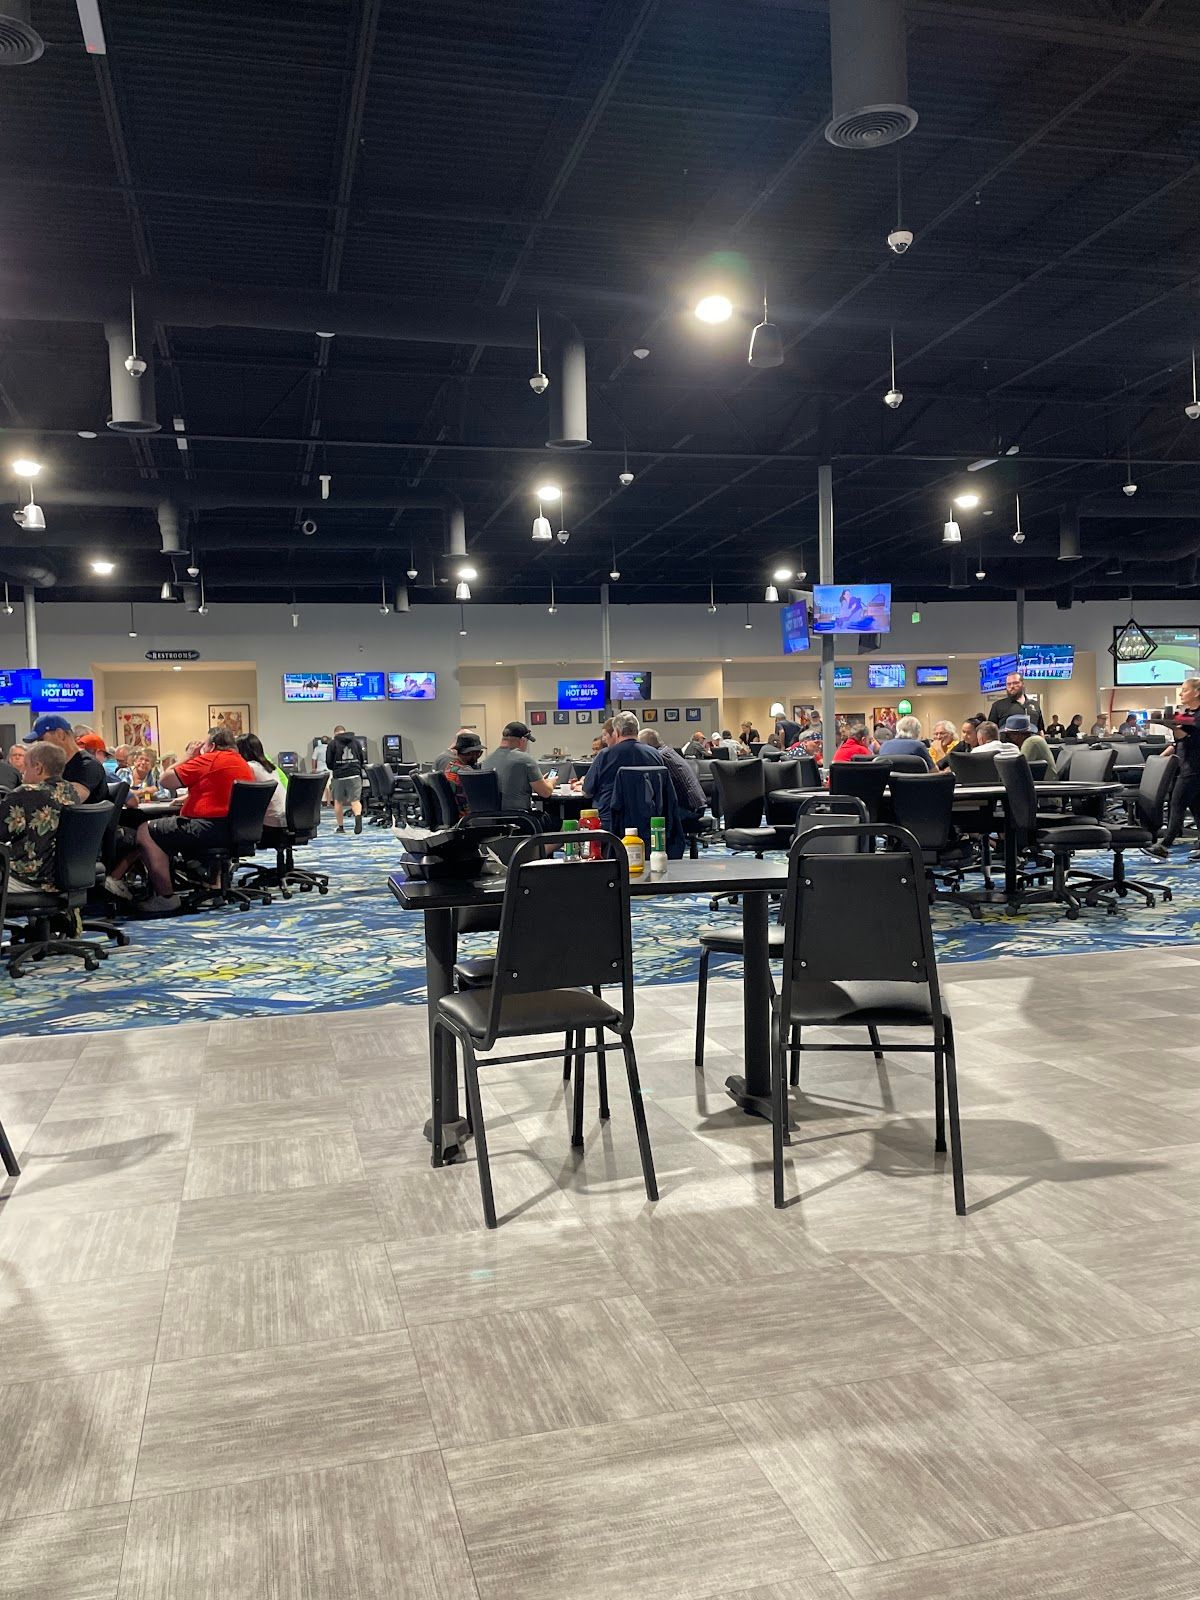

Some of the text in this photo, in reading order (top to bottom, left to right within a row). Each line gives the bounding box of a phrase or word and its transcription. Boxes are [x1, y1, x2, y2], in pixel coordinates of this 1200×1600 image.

[41, 688, 85, 697] HOT BUYS
[566, 688, 598, 696] HOT BUYS
[558, 713, 564, 721] 2
